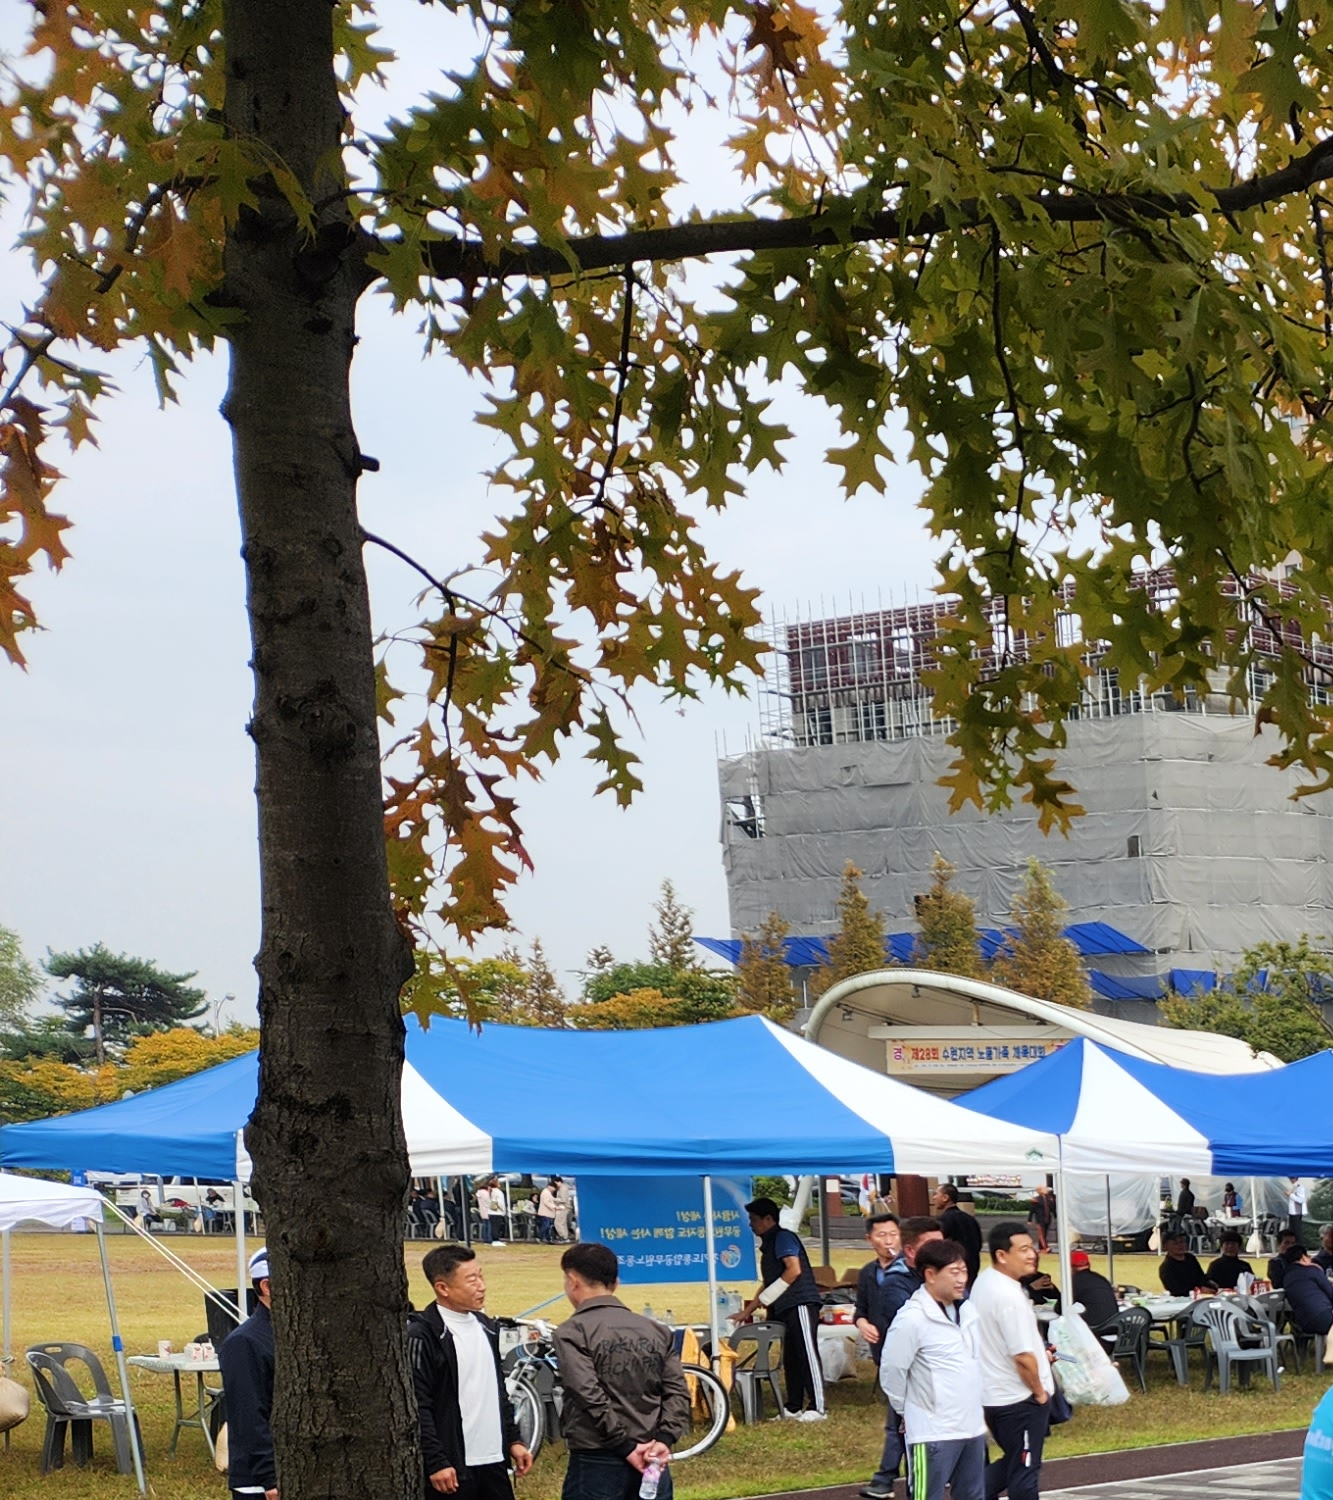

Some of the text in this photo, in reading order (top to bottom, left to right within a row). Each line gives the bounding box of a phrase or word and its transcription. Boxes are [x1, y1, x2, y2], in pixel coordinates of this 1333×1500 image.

[911, 1046, 940, 1061] 제28회
[942, 1045, 975, 1062] 수원지역
[977, 1045, 1010, 1061] 노동가족
[1012, 1044, 1046, 1060] 체육대회
